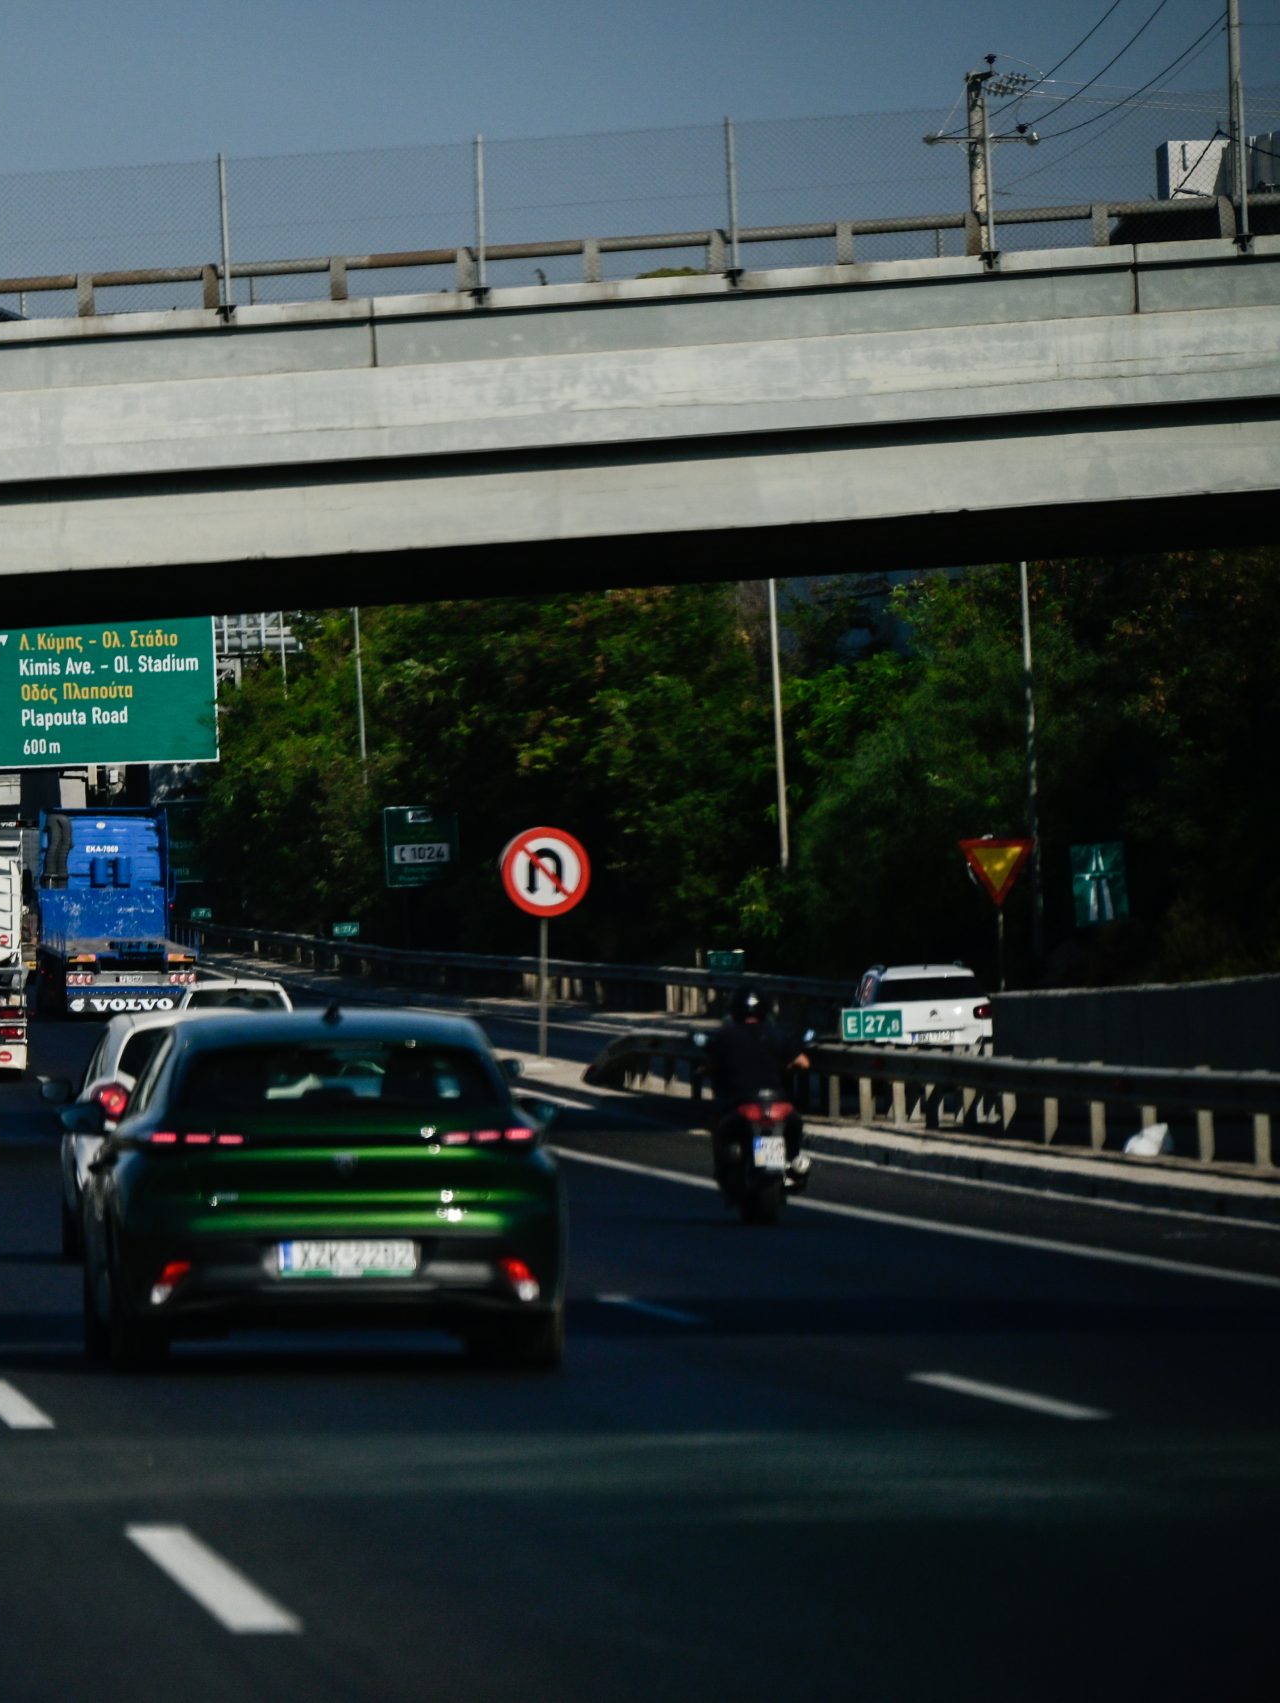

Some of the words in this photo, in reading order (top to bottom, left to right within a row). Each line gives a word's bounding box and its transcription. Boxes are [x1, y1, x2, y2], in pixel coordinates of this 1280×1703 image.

[130, 629, 178, 648] Στάδιο
[19, 658, 61, 676] Kimis
[65, 657, 95, 675] Ave.
[138, 654, 198, 673] Stadium
[21, 684, 58, 704] Οδός
[63, 681, 133, 700] Πλαπούτα
[21, 708, 87, 731] Plapouta
[92, 706, 129, 725] Road
[23, 739, 47, 755] 600
[49, 741, 61, 754] m
[411, 846, 445, 860] 1024
[90, 997, 174, 1012] VOLVO
[846, 1016, 858, 1034] E
